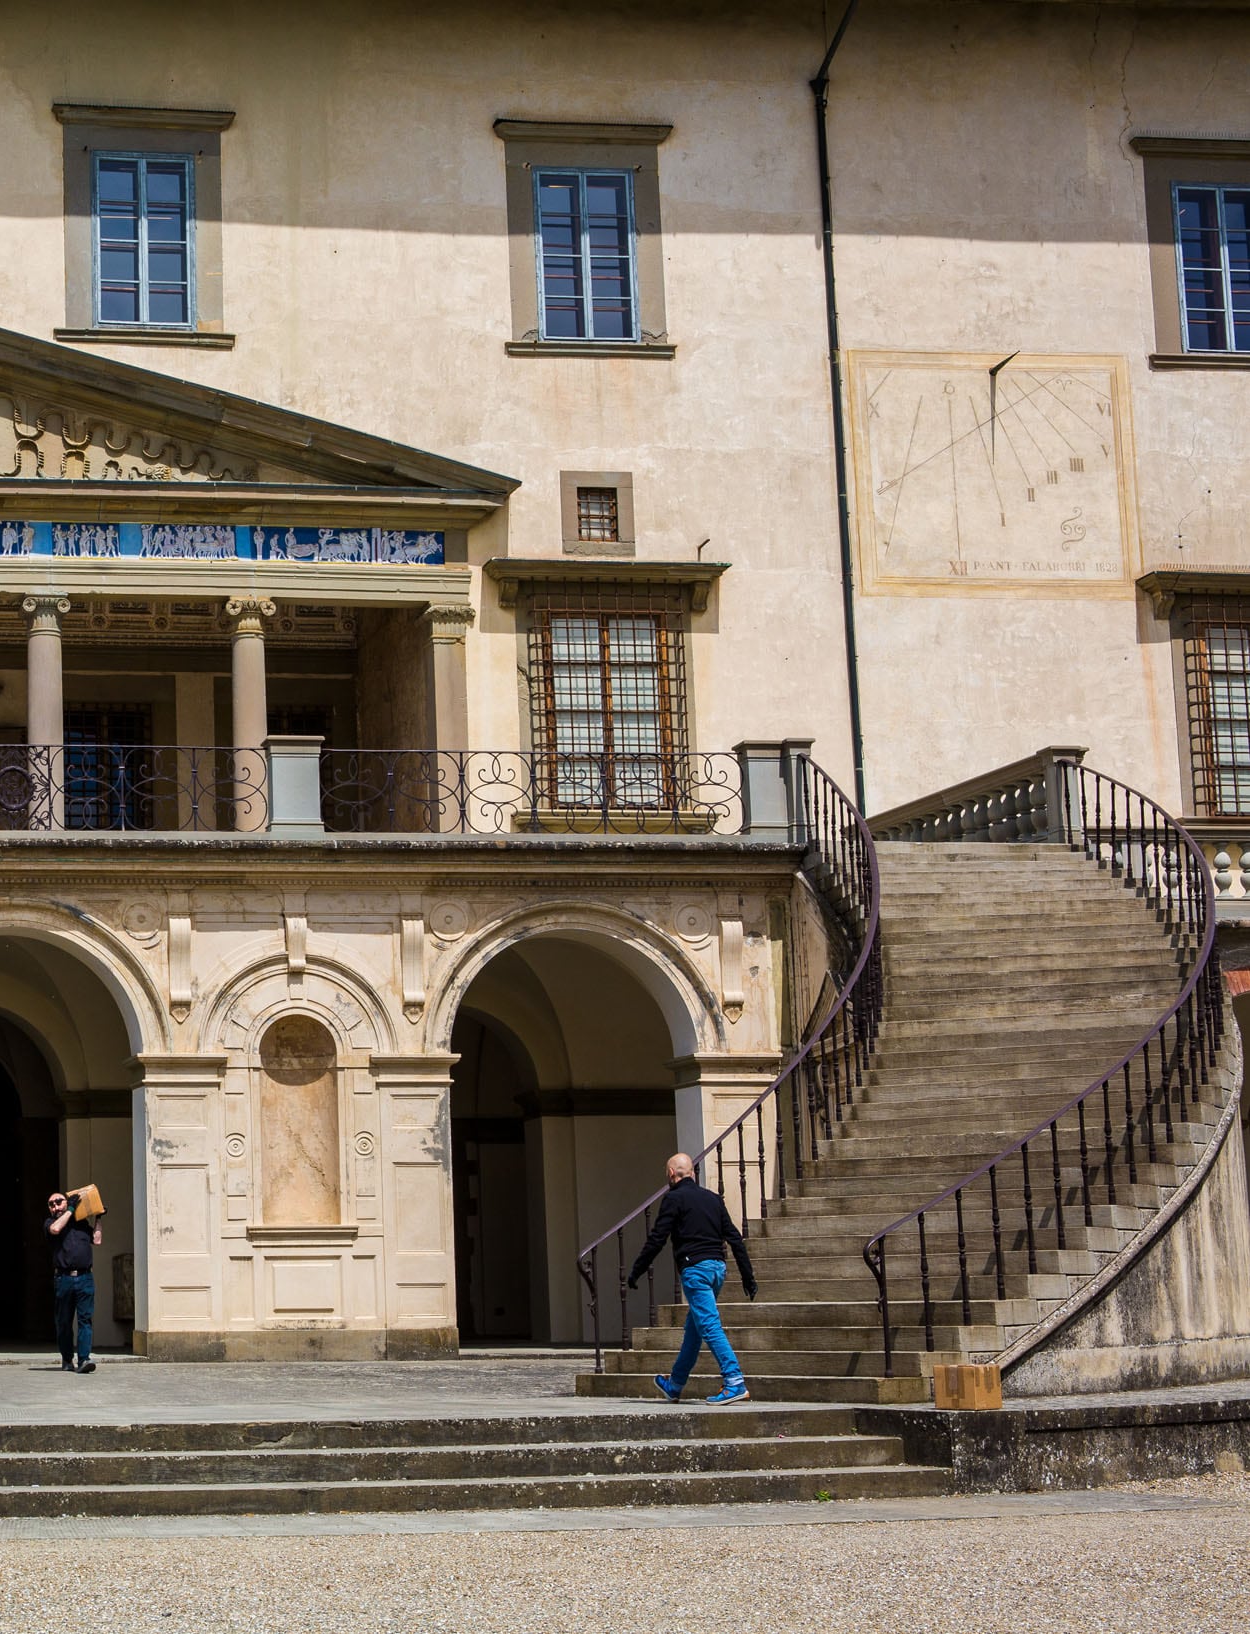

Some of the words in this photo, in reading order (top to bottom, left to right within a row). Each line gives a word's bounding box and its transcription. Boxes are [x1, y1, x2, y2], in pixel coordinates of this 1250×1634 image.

[1096, 402, 1111, 416] VI
[1101, 443, 1111, 458] V
[1069, 457, 1085, 472] IIII
[1046, 470, 1058, 485] III
[1027, 487, 1036, 502] II
